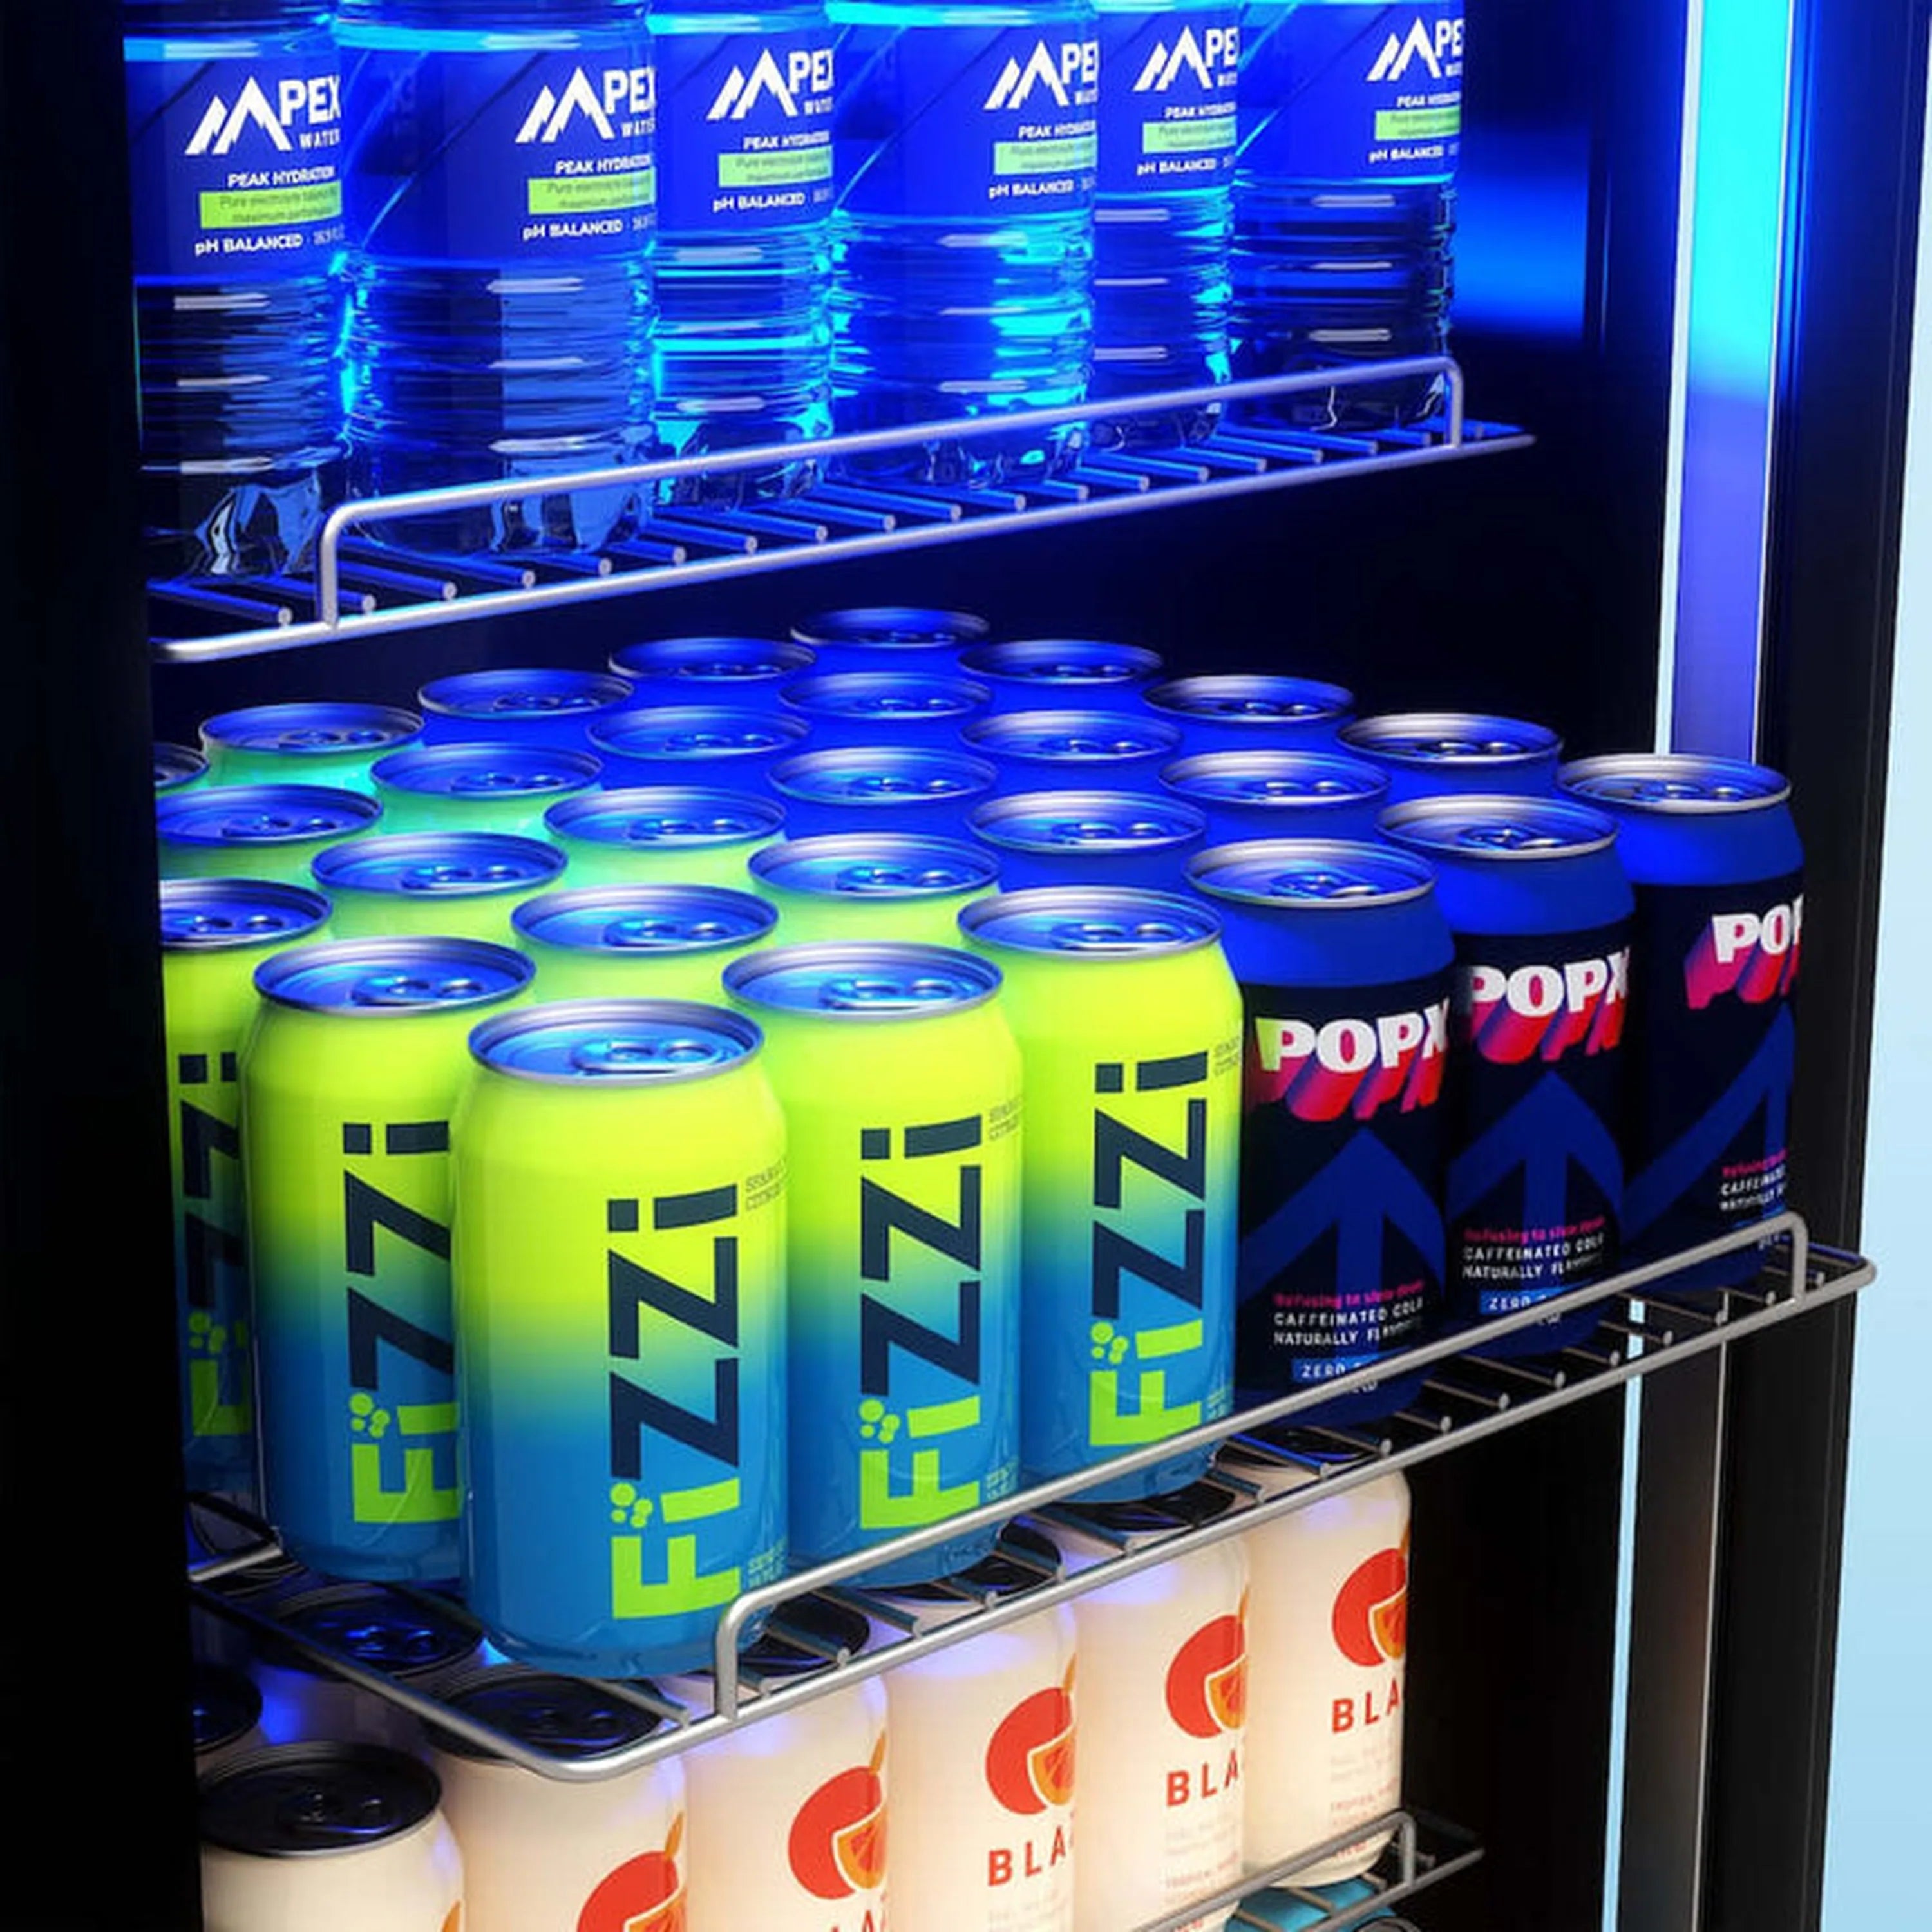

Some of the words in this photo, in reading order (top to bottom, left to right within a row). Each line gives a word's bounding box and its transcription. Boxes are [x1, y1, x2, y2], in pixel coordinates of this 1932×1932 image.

[1132, 26, 1238, 91] APE
[1367, 17, 1464, 81] APE
[983, 39, 1098, 109] APE
[743, 136, 779, 150] PEAK
[555, 160, 594, 175] PEAK
[227, 172, 270, 188] PEAK
[713, 196, 734, 213] pH
[737, 192, 804, 209] BALANCED
[522, 225, 545, 242] pH
[549, 220, 623, 238] BALANCED
[195, 239, 219, 256] pH
[223, 233, 304, 253] BALANCED
[1273, 1306, 1388, 1327] CAFFEINATED
[1273, 1329, 1359, 1347] NATURALLY
[988, 1824, 1074, 1888] BLA
